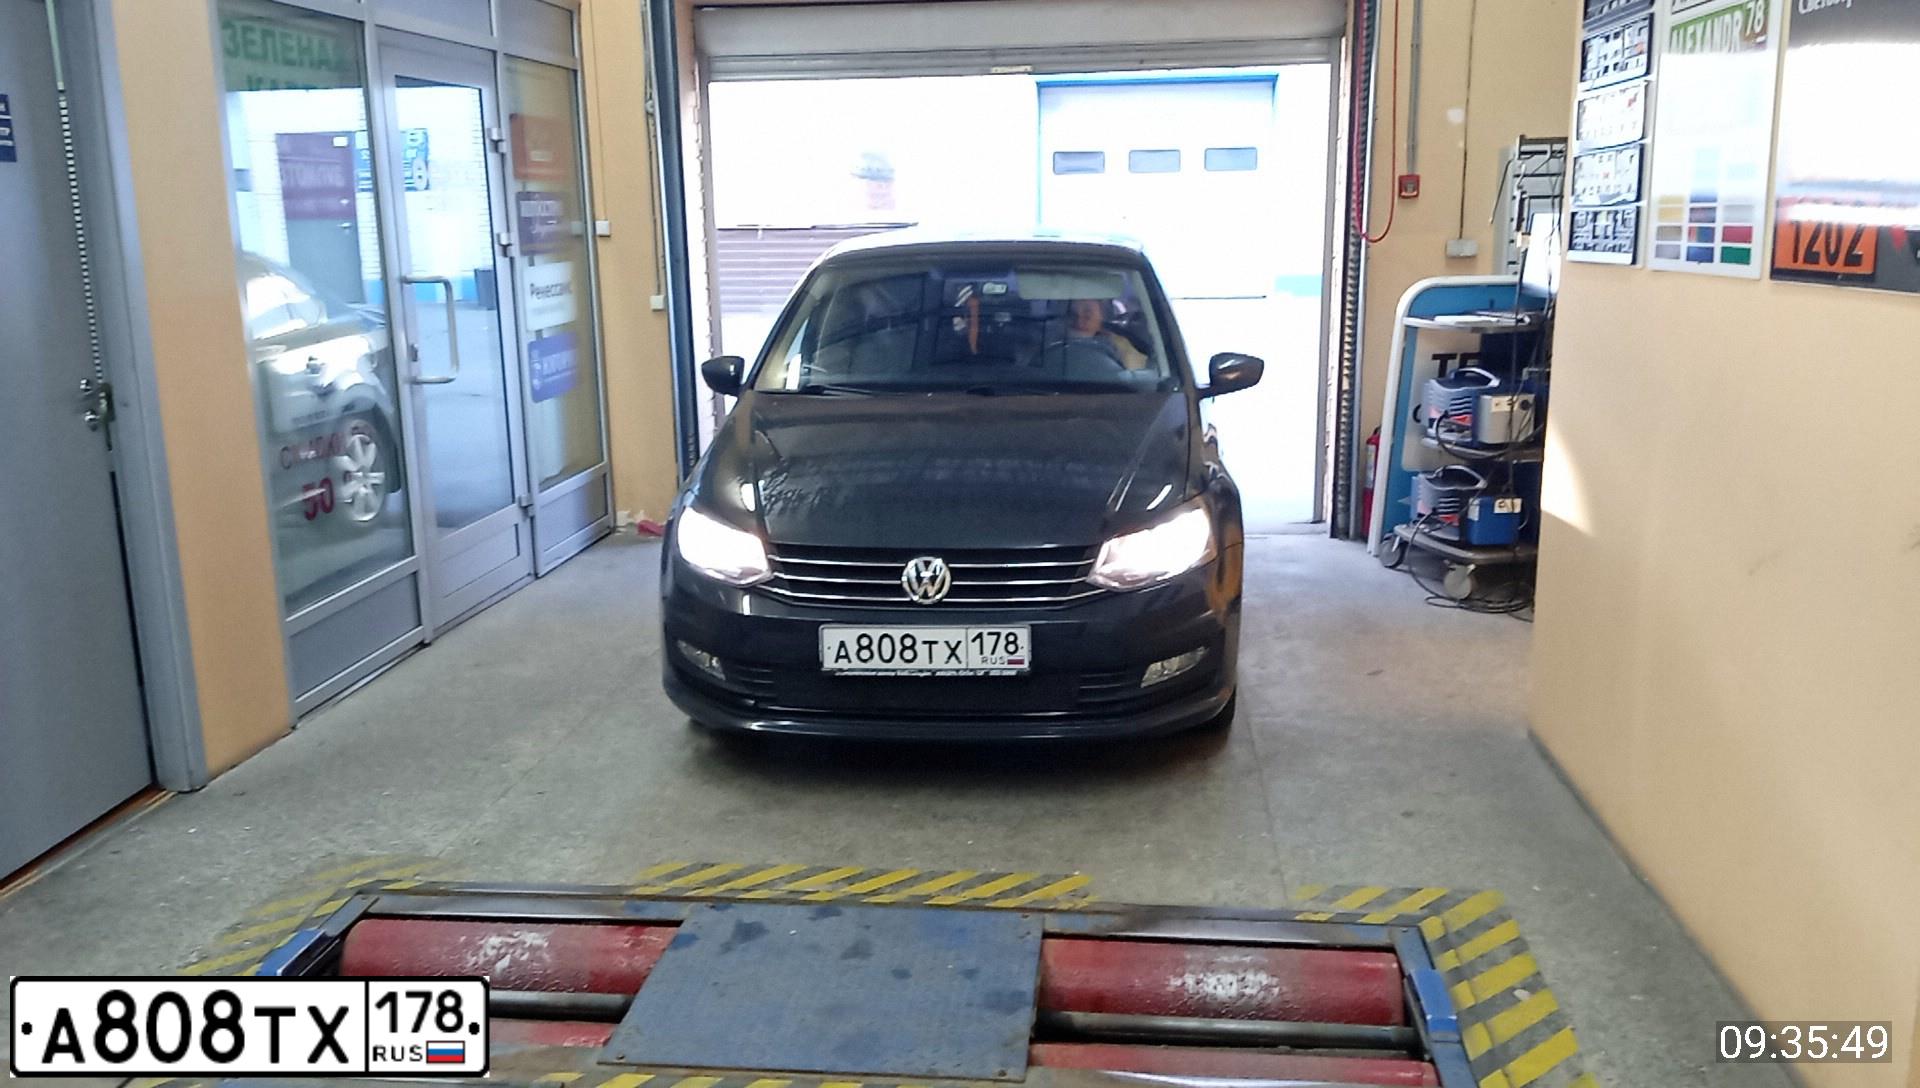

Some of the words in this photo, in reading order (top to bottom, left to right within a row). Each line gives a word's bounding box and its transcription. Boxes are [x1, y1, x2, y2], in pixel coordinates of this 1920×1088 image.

[1791, 219, 1864, 267] 1202
[971, 631, 1019, 656] 178
[981, 655, 1006, 665] RUS
